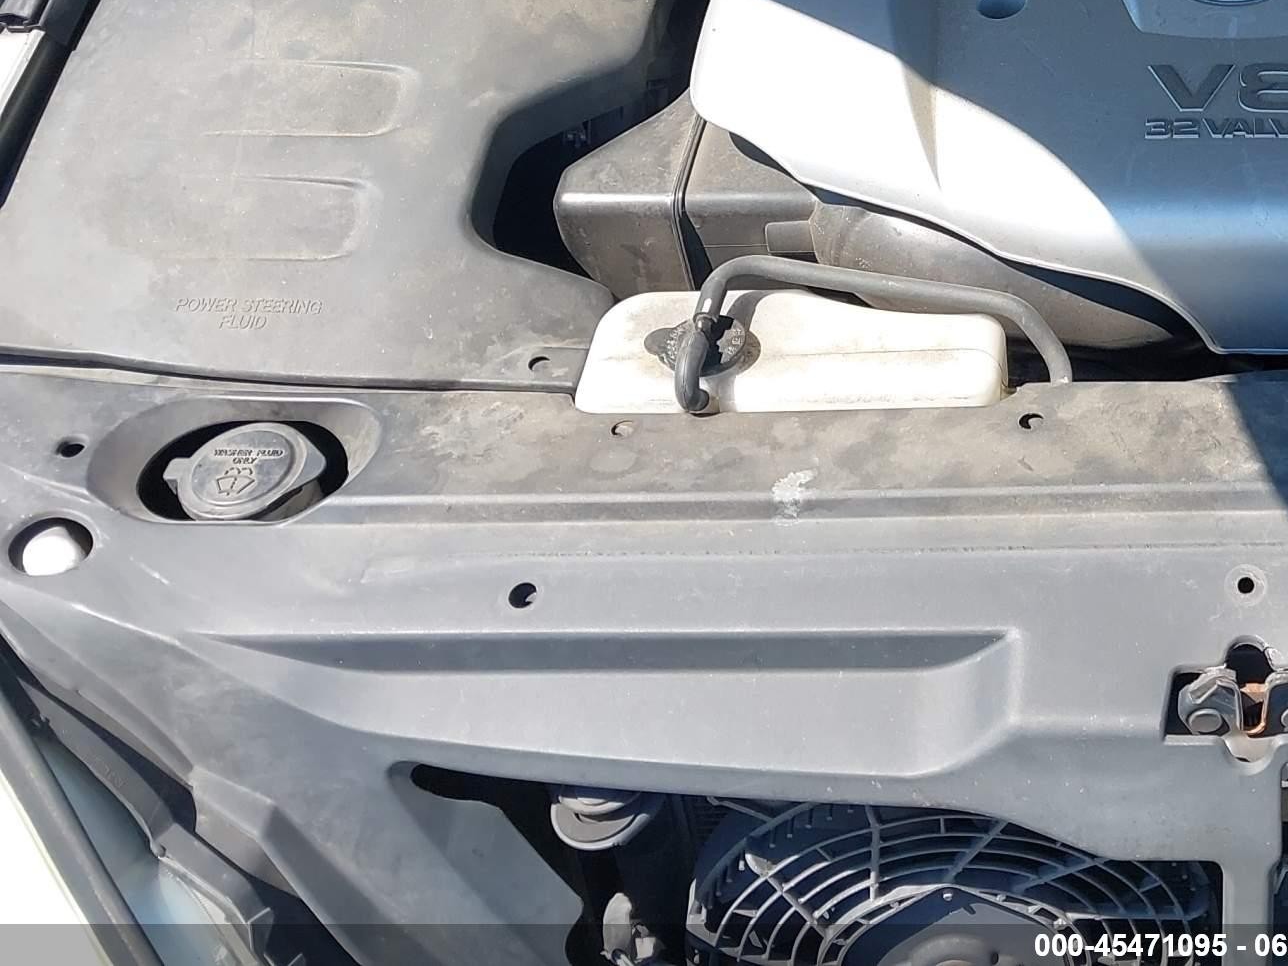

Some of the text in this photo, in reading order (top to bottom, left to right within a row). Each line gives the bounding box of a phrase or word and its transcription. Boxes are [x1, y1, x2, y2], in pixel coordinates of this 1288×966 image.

[175, 298, 323, 315] POWER STEERING
[217, 314, 268, 330] FLUID
